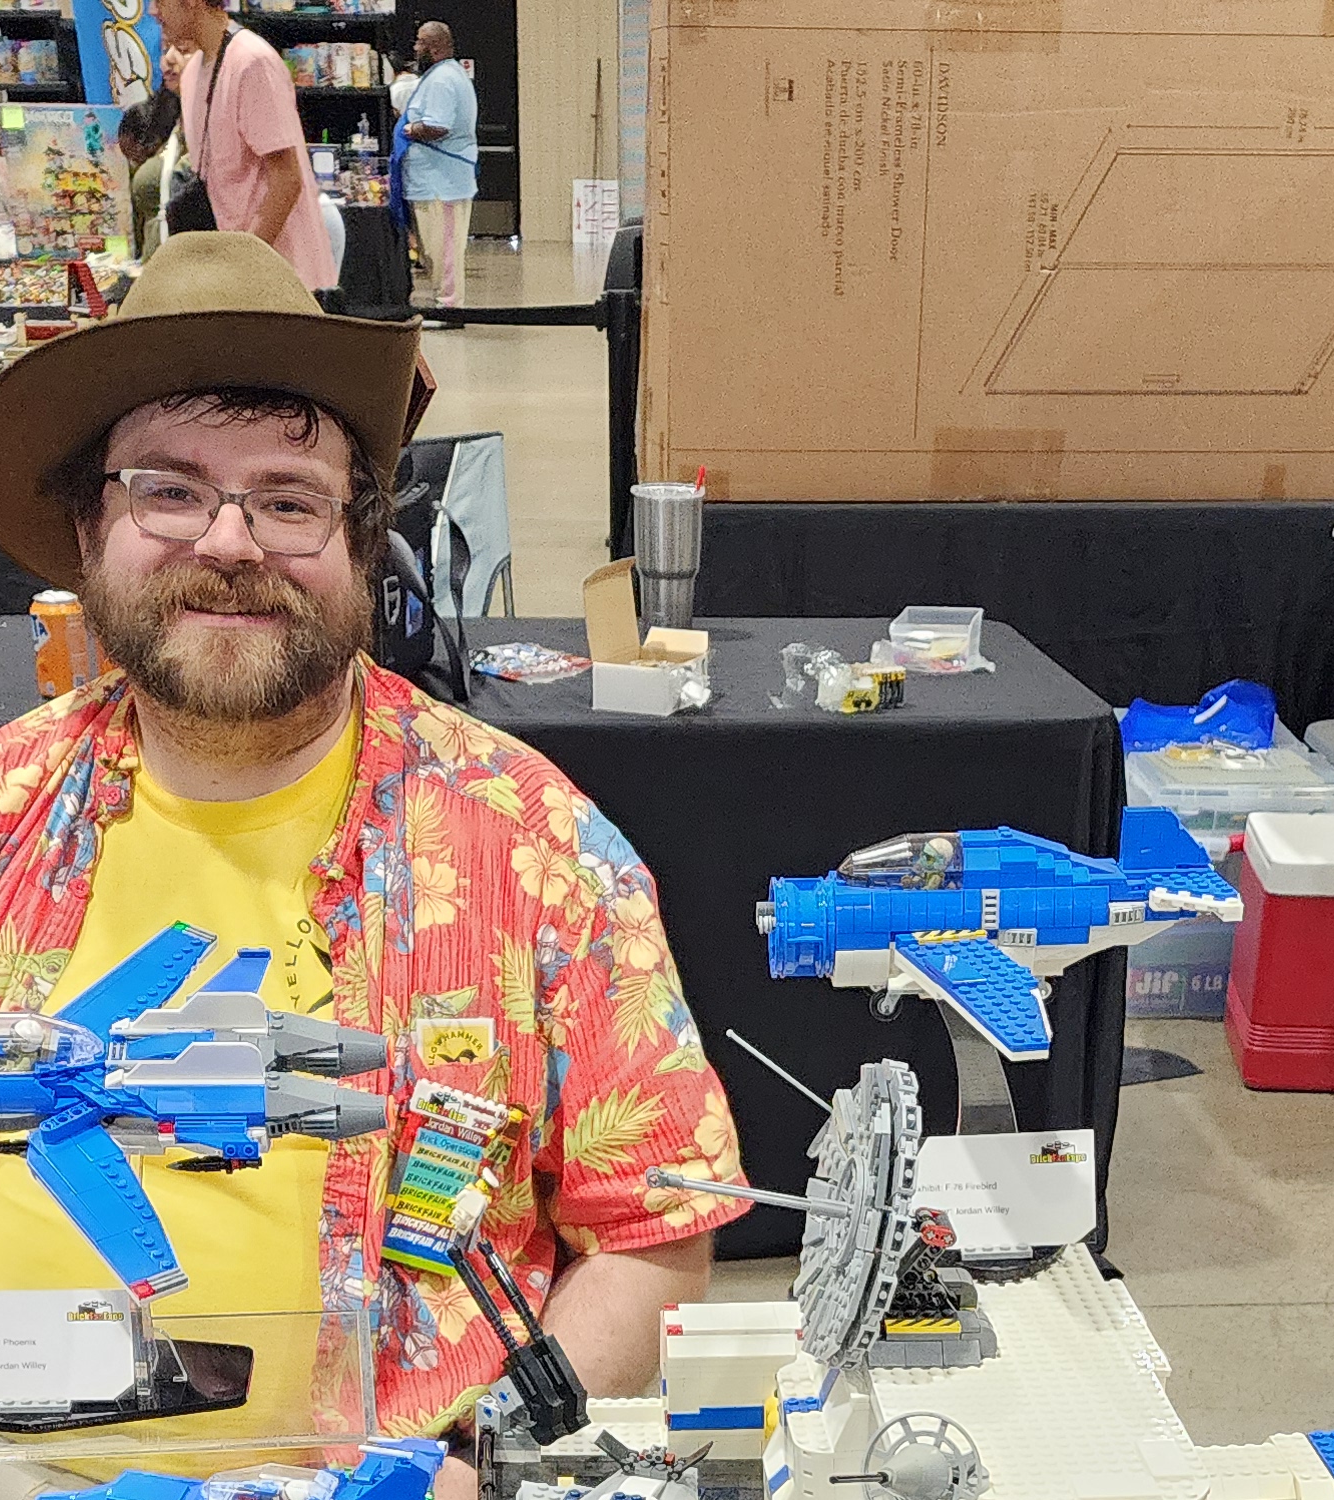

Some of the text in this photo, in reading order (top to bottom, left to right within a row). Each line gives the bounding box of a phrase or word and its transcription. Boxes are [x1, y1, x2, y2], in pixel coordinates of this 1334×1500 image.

[935, 61, 950, 147] DAVIDSON
[427, 1030, 483, 1066] LLOWHAMMER
[424, 1117, 455, 1135] Jordan
[457, 1125, 485, 1145] Willey
[965, 1181, 998, 1191] Firebird
[955, 1206, 983, 1216] Jordan
[984, 1205, 1010, 1216] Willey
[3, 1338, 37, 1347] Phoenix
[21, 1361, 47, 1371] Willey
